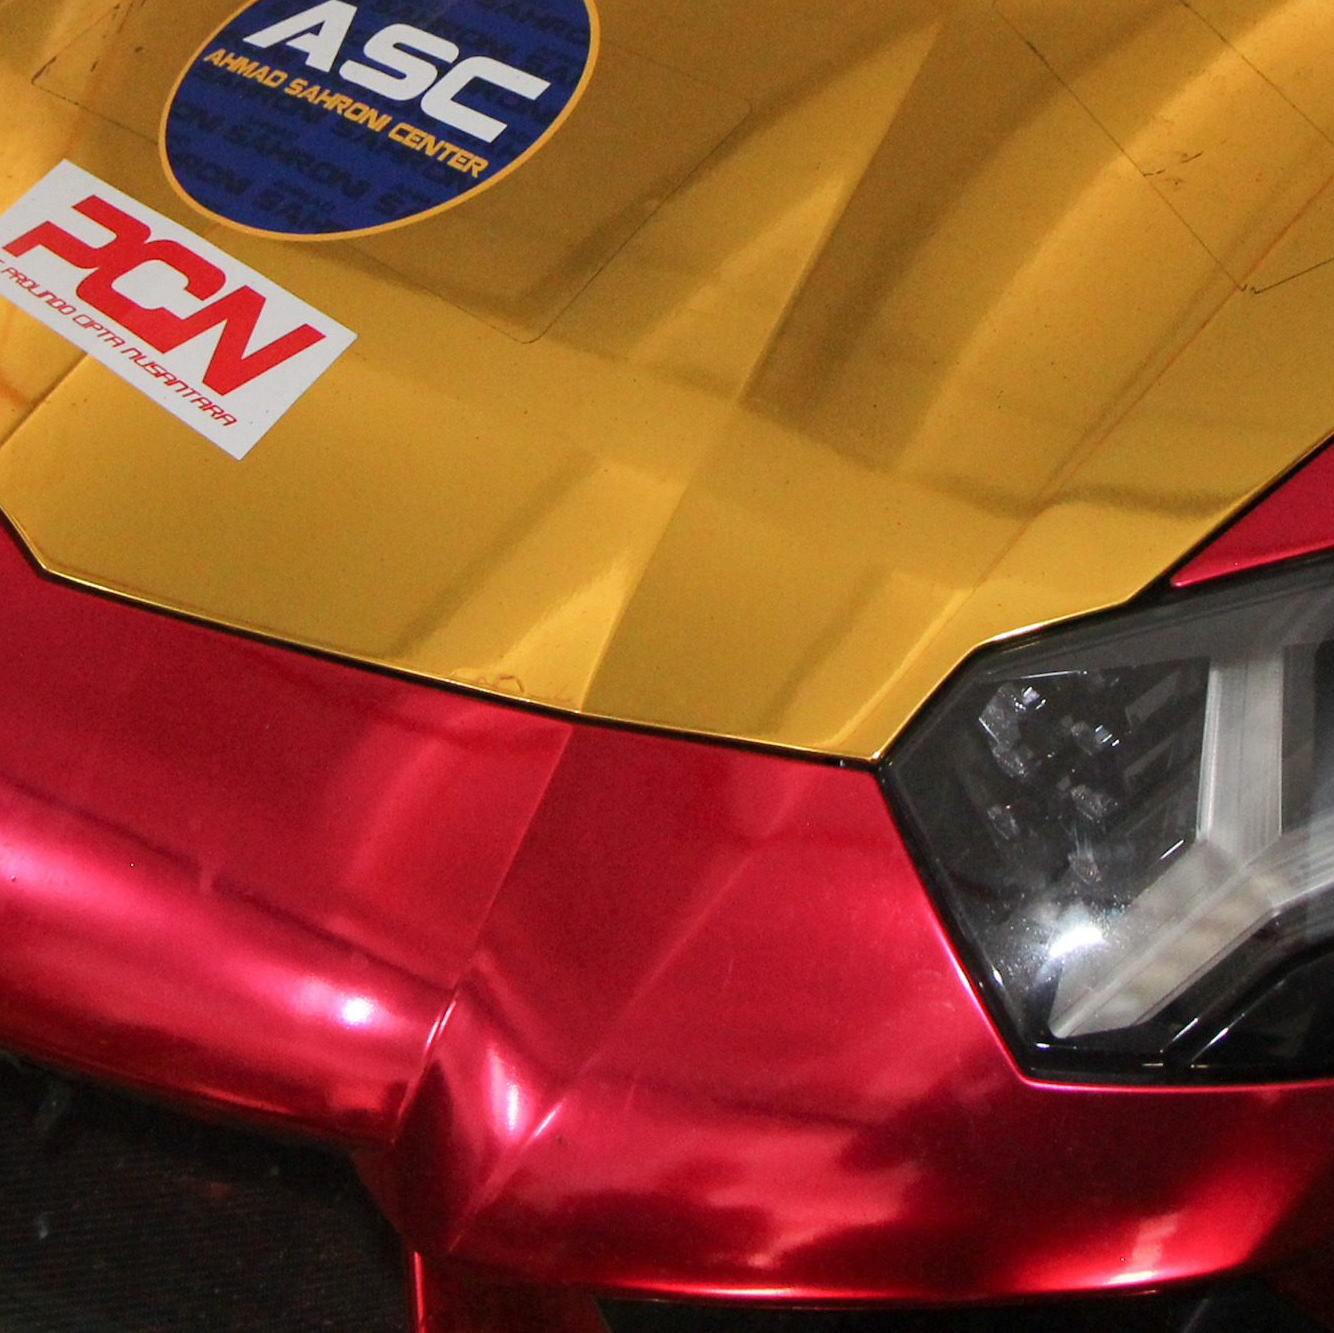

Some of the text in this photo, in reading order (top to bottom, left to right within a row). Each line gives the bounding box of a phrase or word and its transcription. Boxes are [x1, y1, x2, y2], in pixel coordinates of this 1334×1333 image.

[203, 47, 288, 90] AHMAD
[283, 77, 392, 132] SAHRONI
[388, 122, 490, 179] CENTER
[0, 266, 77, 316] PROLINDO
[72, 313, 126, 348] CIPTA
[120, 347, 238, 427] NUSANTARA
[1, 194, 327, 397] PCN
